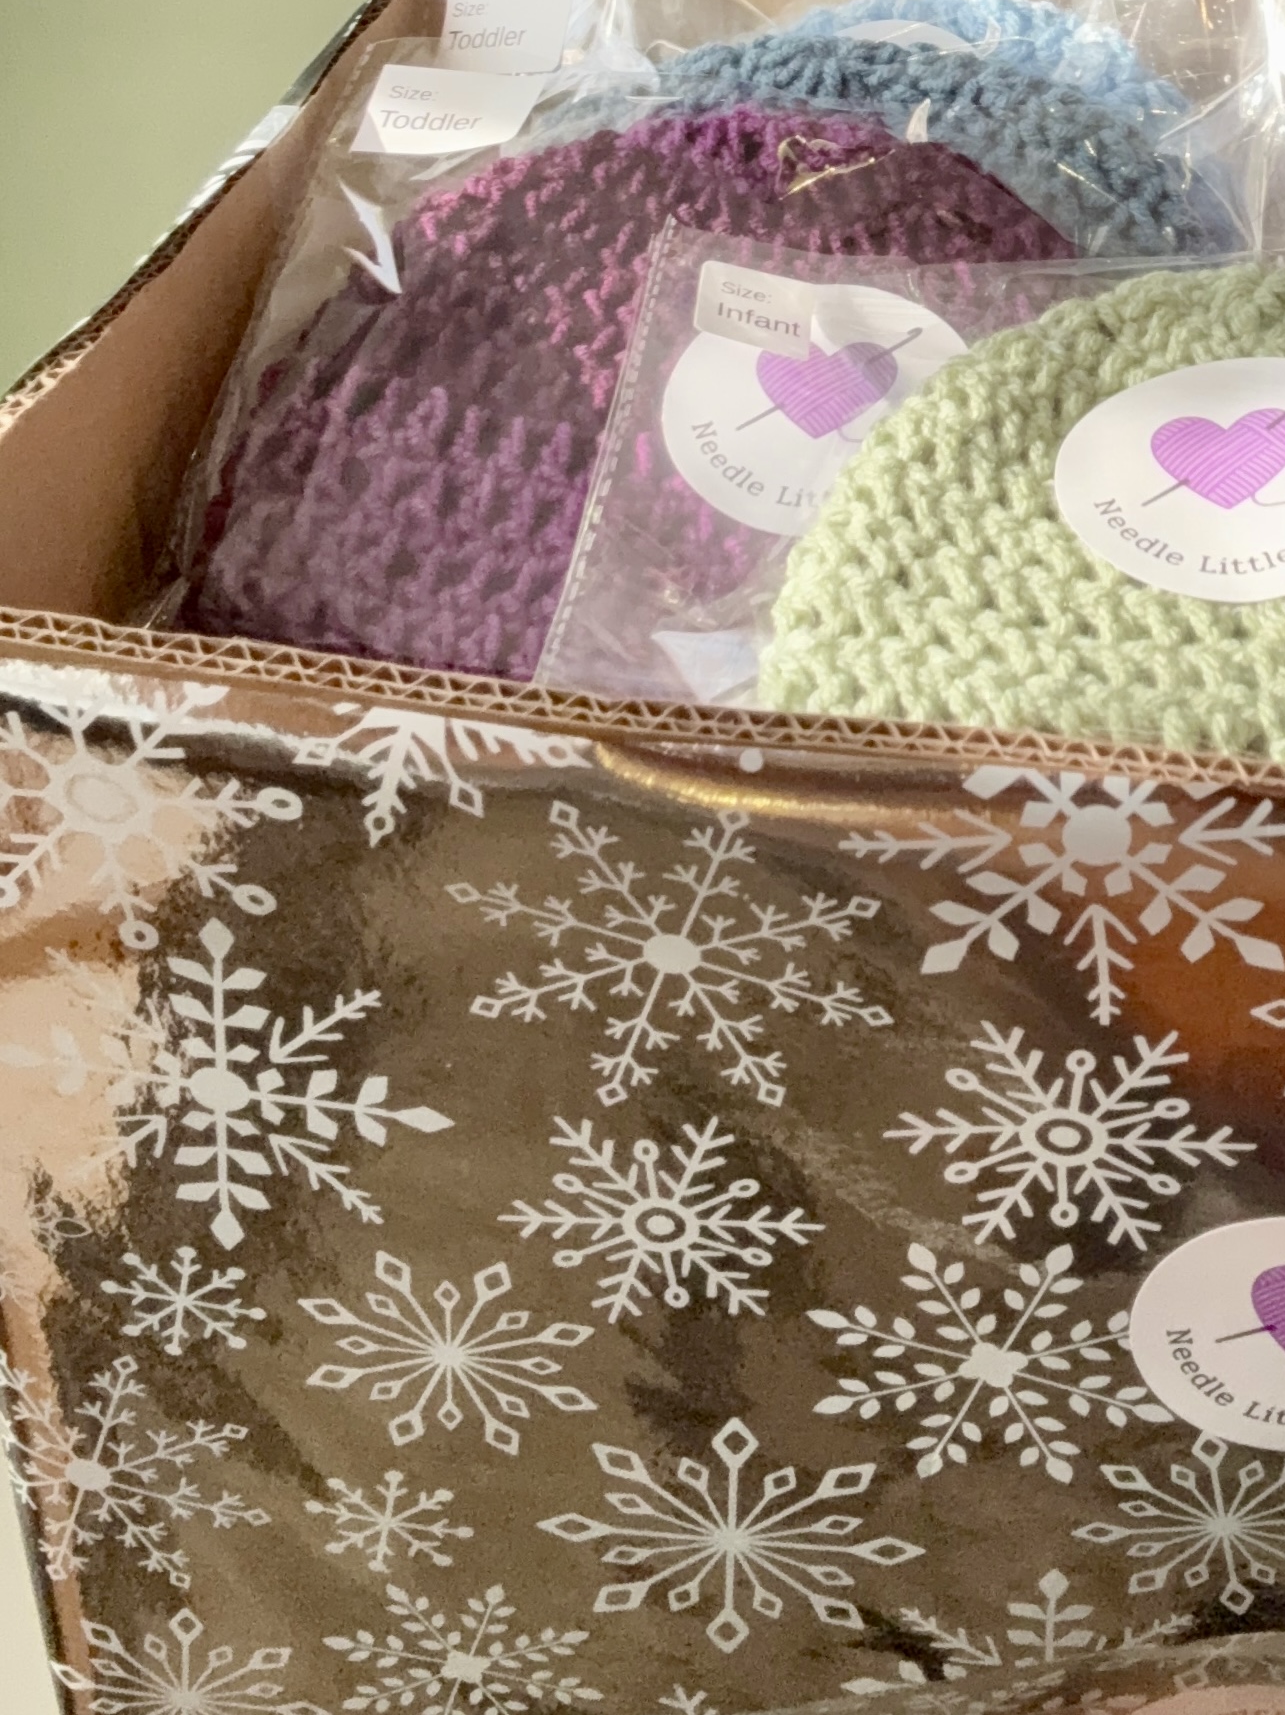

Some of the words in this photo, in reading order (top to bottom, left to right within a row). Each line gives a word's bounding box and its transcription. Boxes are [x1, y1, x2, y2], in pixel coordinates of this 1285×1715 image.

[448, 26, 527, 50] Toddler
[379, 109, 482, 131] Toddler
[720, 280, 772, 304] Size:
[717, 302, 801, 337] Infant
[691, 420, 765, 497] Needle
[1093, 497, 1185, 566] Needle
[1165, 1327, 1235, 1407] Needle
